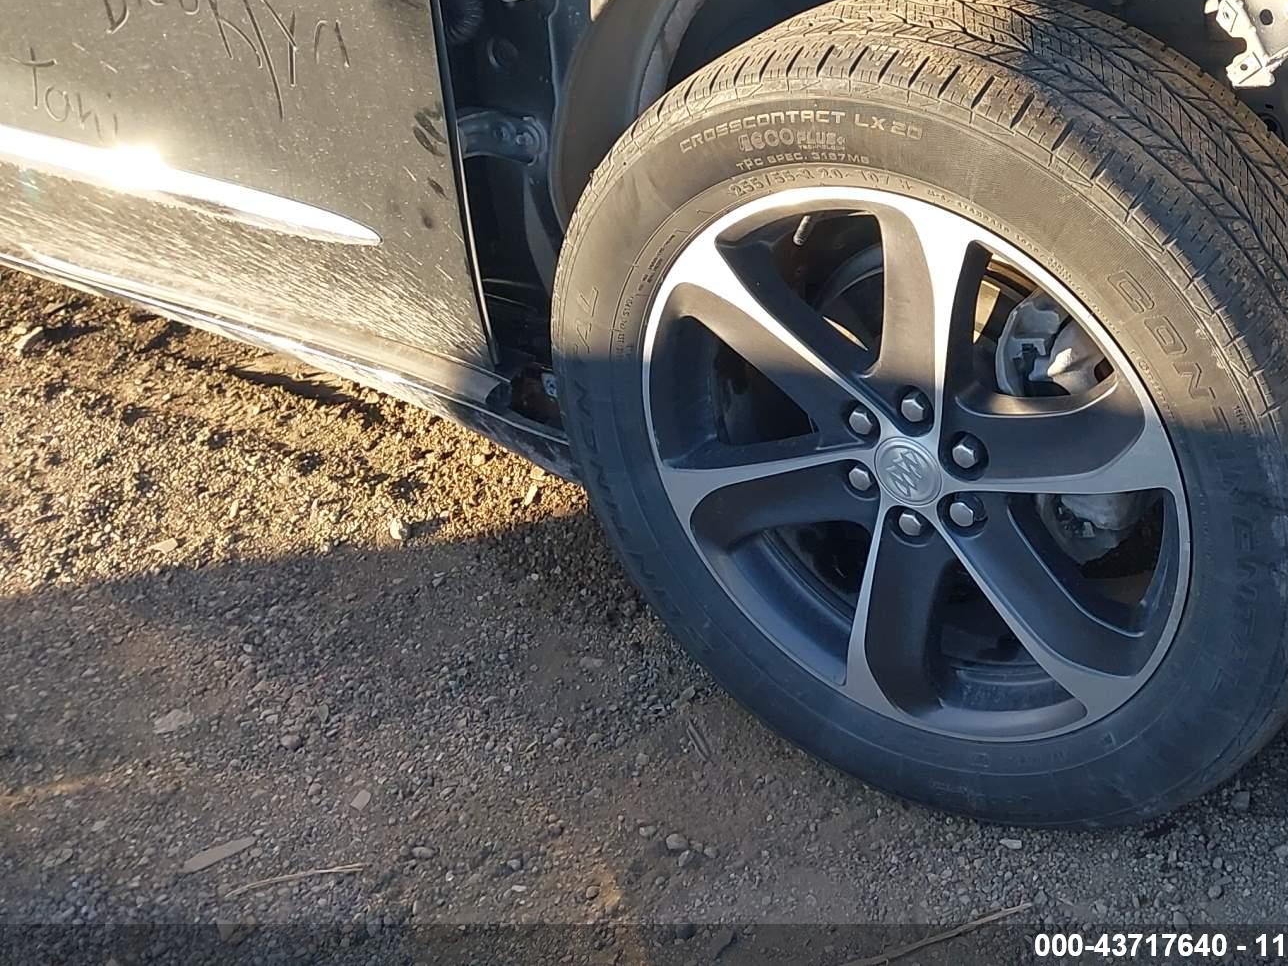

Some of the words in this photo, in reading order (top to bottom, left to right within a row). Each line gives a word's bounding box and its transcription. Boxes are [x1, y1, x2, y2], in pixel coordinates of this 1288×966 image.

[679, 110, 847, 153] CROSSCONTACT
[854, 114, 887, 130] LX
[890, 121, 924, 141] 20
